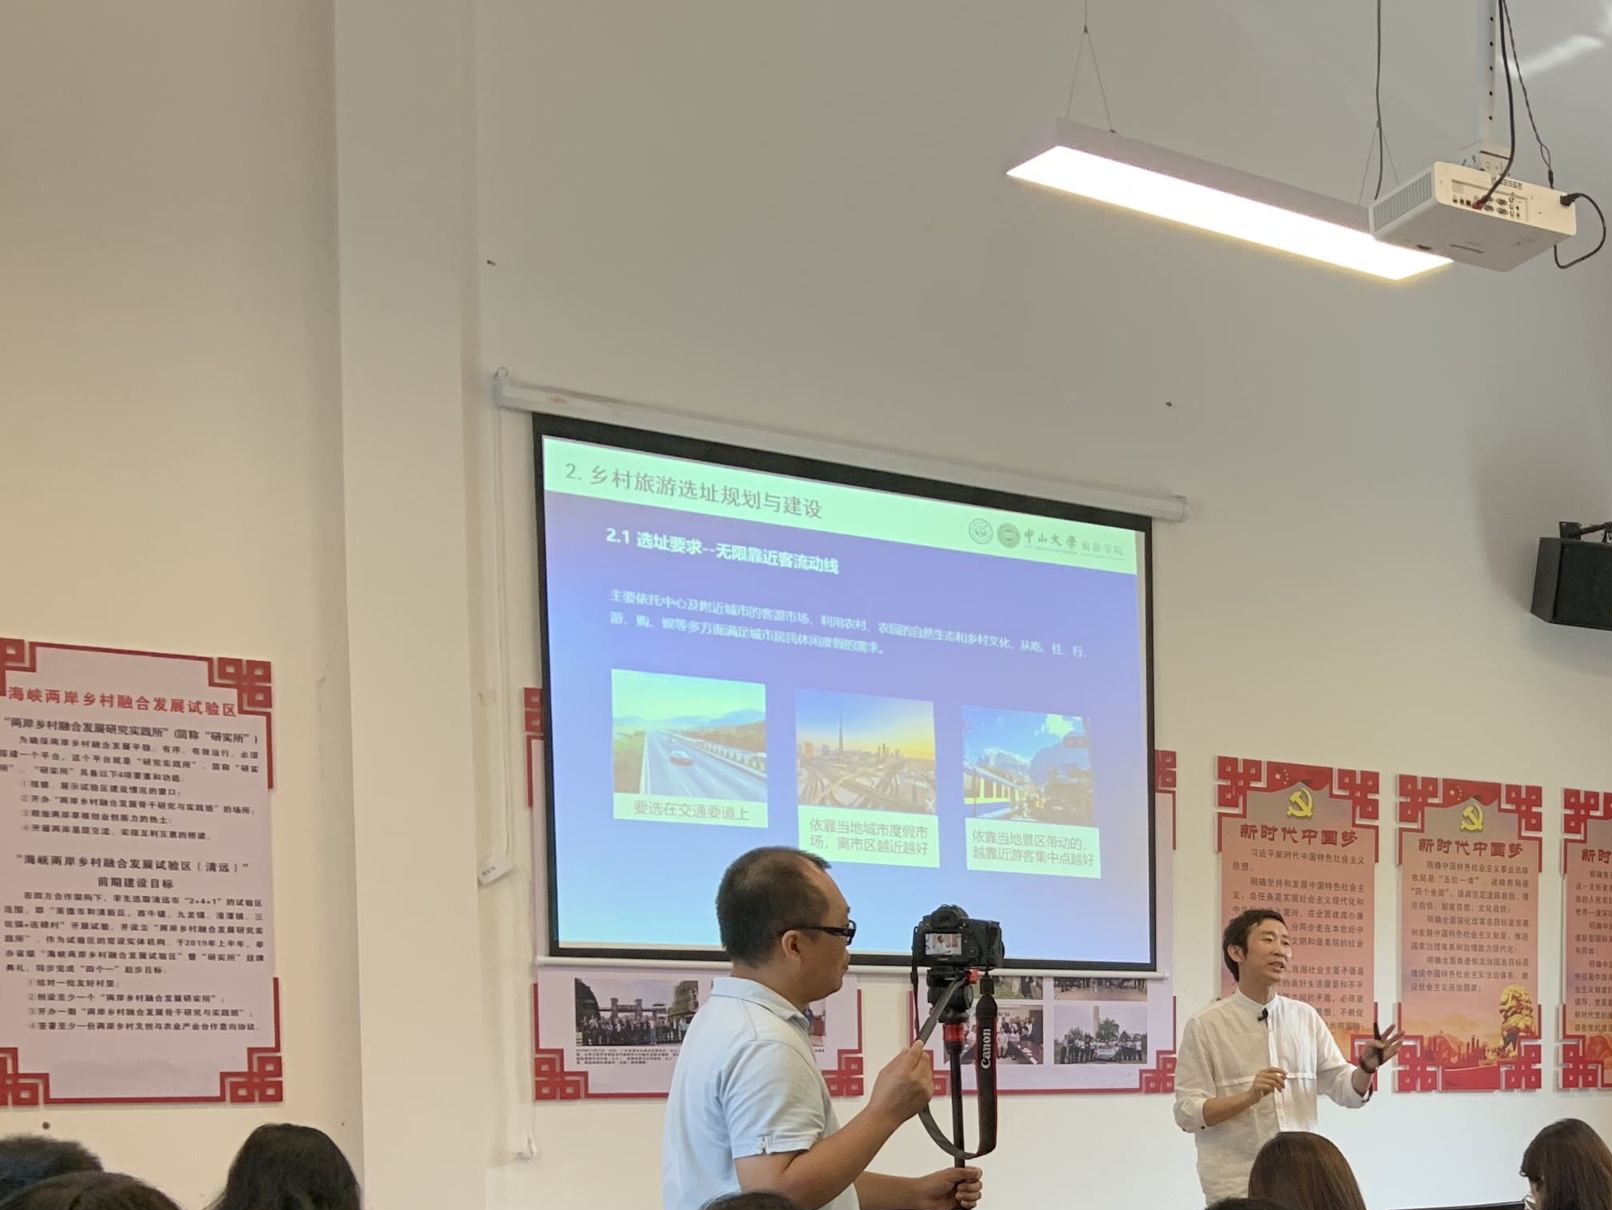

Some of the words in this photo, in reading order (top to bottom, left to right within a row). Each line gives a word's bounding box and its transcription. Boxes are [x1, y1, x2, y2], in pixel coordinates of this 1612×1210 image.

[589, 464, 822, 519] 乡村旅游选址规划与建设
[606, 527, 630, 544] 2.1
[8, 686, 236, 717] 海峡两岸乡村融合发展试验区
[633, 800, 749, 822] 要选在交通要道上
[1240, 824, 1358, 847] 新时代中国梦
[1419, 838, 1523, 859] 新时代中国梦
[98, 877, 174, 889] 前期建设目标
[981, 1028, 991, 1070] Canon
